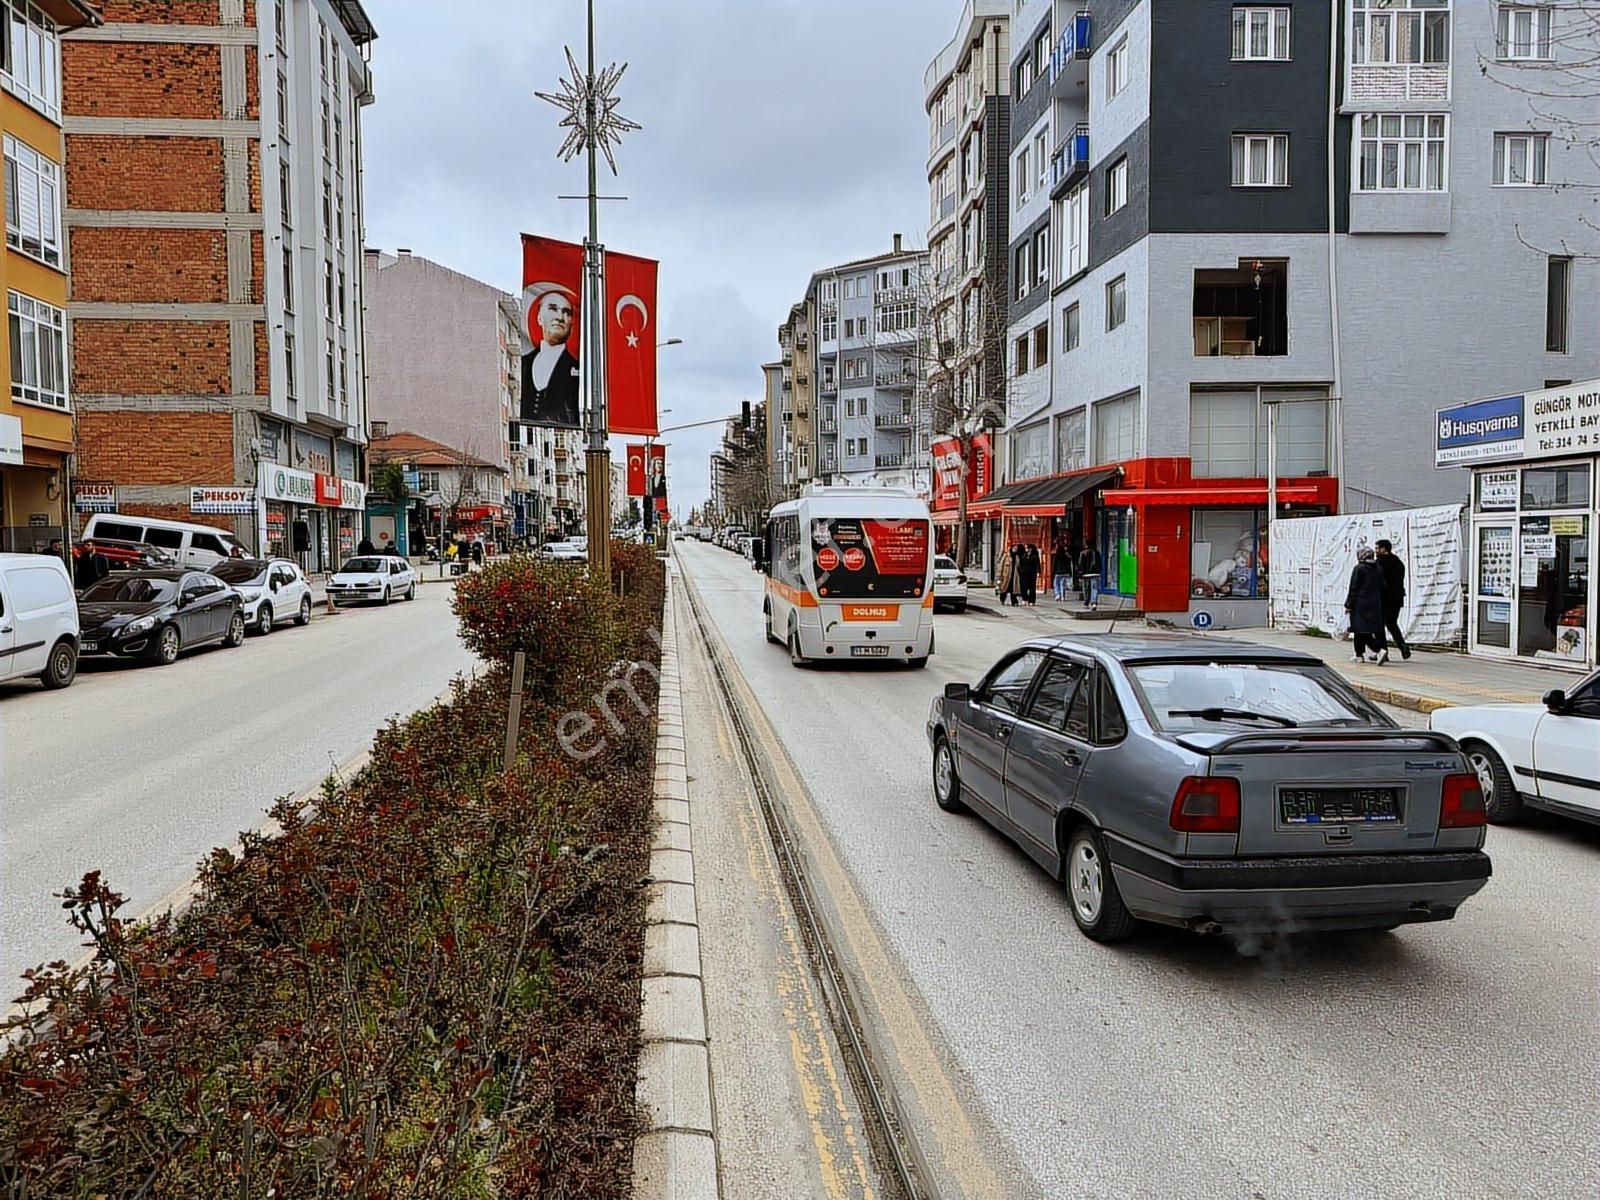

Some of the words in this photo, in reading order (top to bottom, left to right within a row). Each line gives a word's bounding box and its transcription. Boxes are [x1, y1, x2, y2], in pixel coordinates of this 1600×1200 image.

[1534, 397, 1571, 415] GÜNGÖR
[1578, 392, 1600, 409] MOT
[1453, 413, 1518, 437] Husqvarna
[1535, 416, 1575, 433] YETKİLİ
[1556, 436, 1571, 448] 314
[75, 485, 113, 495] PEKSOY
[205, 491, 246, 501] PEKSOY
[853, 607, 887, 617] DOLMUŞ
[1199, 614, 1208, 625] D
